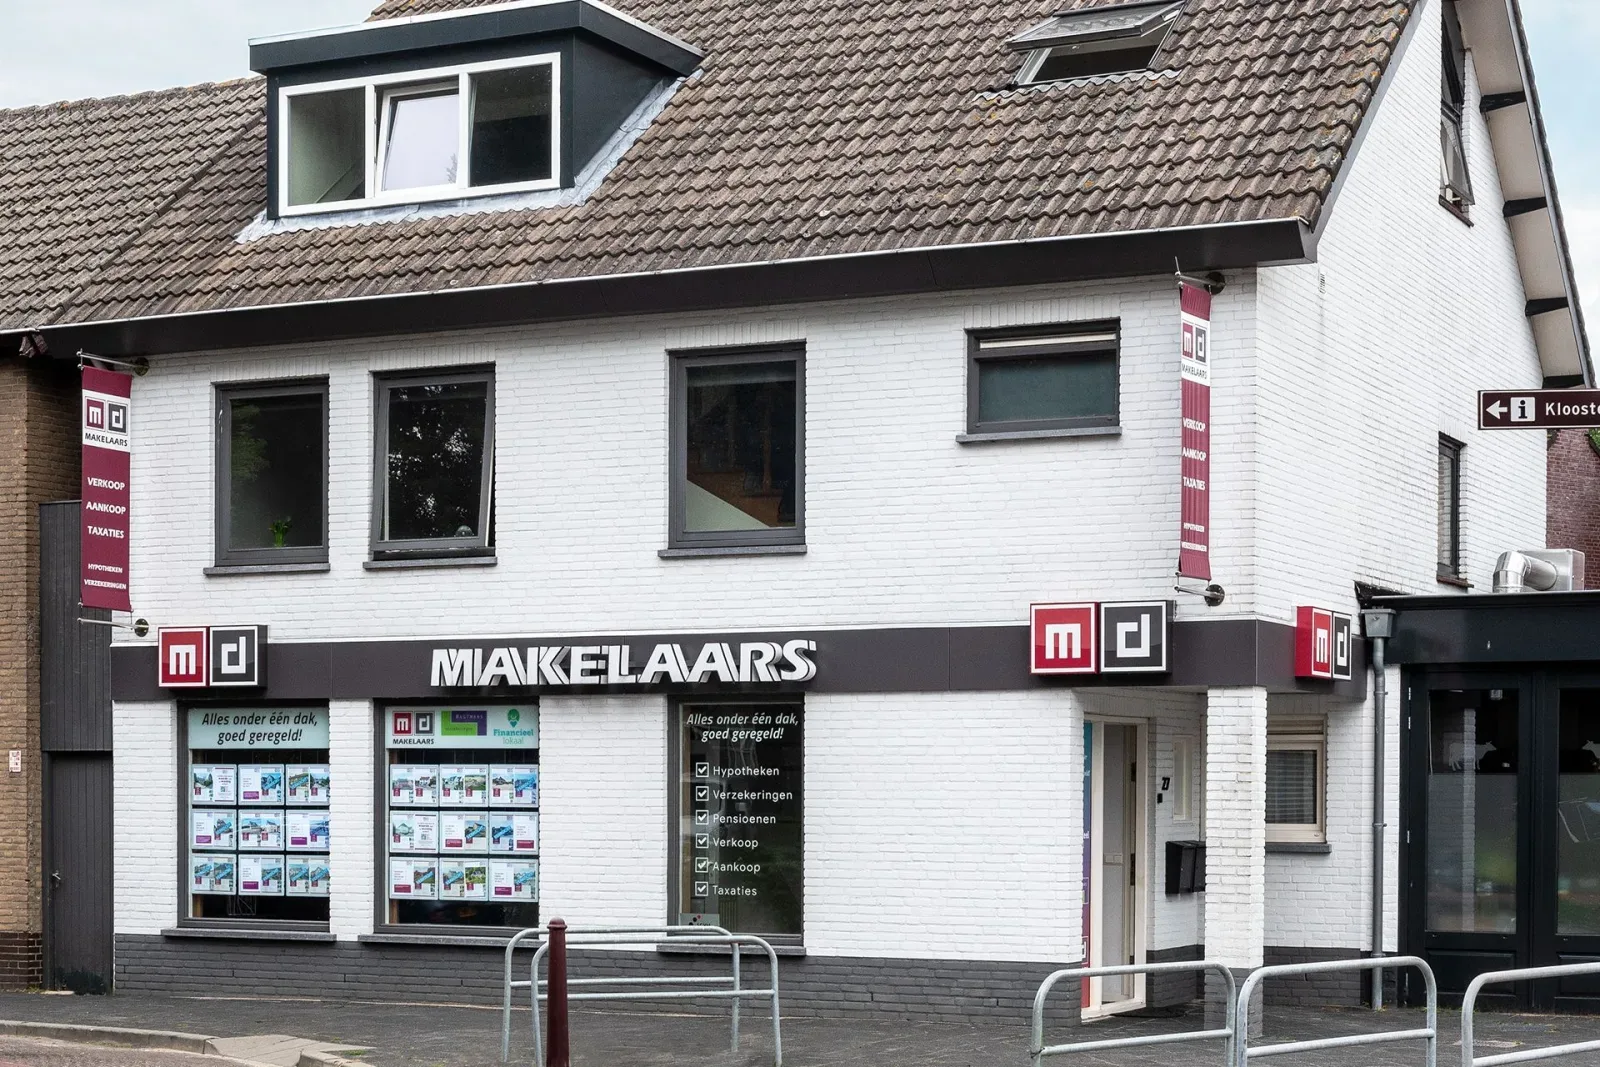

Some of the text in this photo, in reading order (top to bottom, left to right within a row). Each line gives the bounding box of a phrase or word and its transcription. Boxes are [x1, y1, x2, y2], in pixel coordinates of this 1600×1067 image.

[85, 432, 128, 447] MAKELAARS
[87, 477, 125, 491] VERKOOP
[86, 501, 127, 515] AANKOOP
[87, 525, 125, 539] TAXATIES
[87, 563, 123, 574] HYPOTHEKEN
[84, 579, 127, 590] VERZEKERINGEN
[430, 640, 817, 687] MAKELAARS
[202, 711, 318, 727] Alles onder één dak,
[686, 712, 799, 726] Alles onder één dak,
[217, 729, 303, 745] goed geregeld!
[493, 728, 534, 737] Financieel
[701, 727, 784, 743] goed geregeld!
[502, 736, 525, 745] lokaal
[713, 765, 780, 778] Hypotheken
[713, 789, 793, 802] Verzekeringen
[713, 813, 776, 824] Pensioenen
[713, 837, 759, 850] Verkoop
[712, 861, 761, 874] Aankoop
[712, 885, 757, 896] Taxaties
